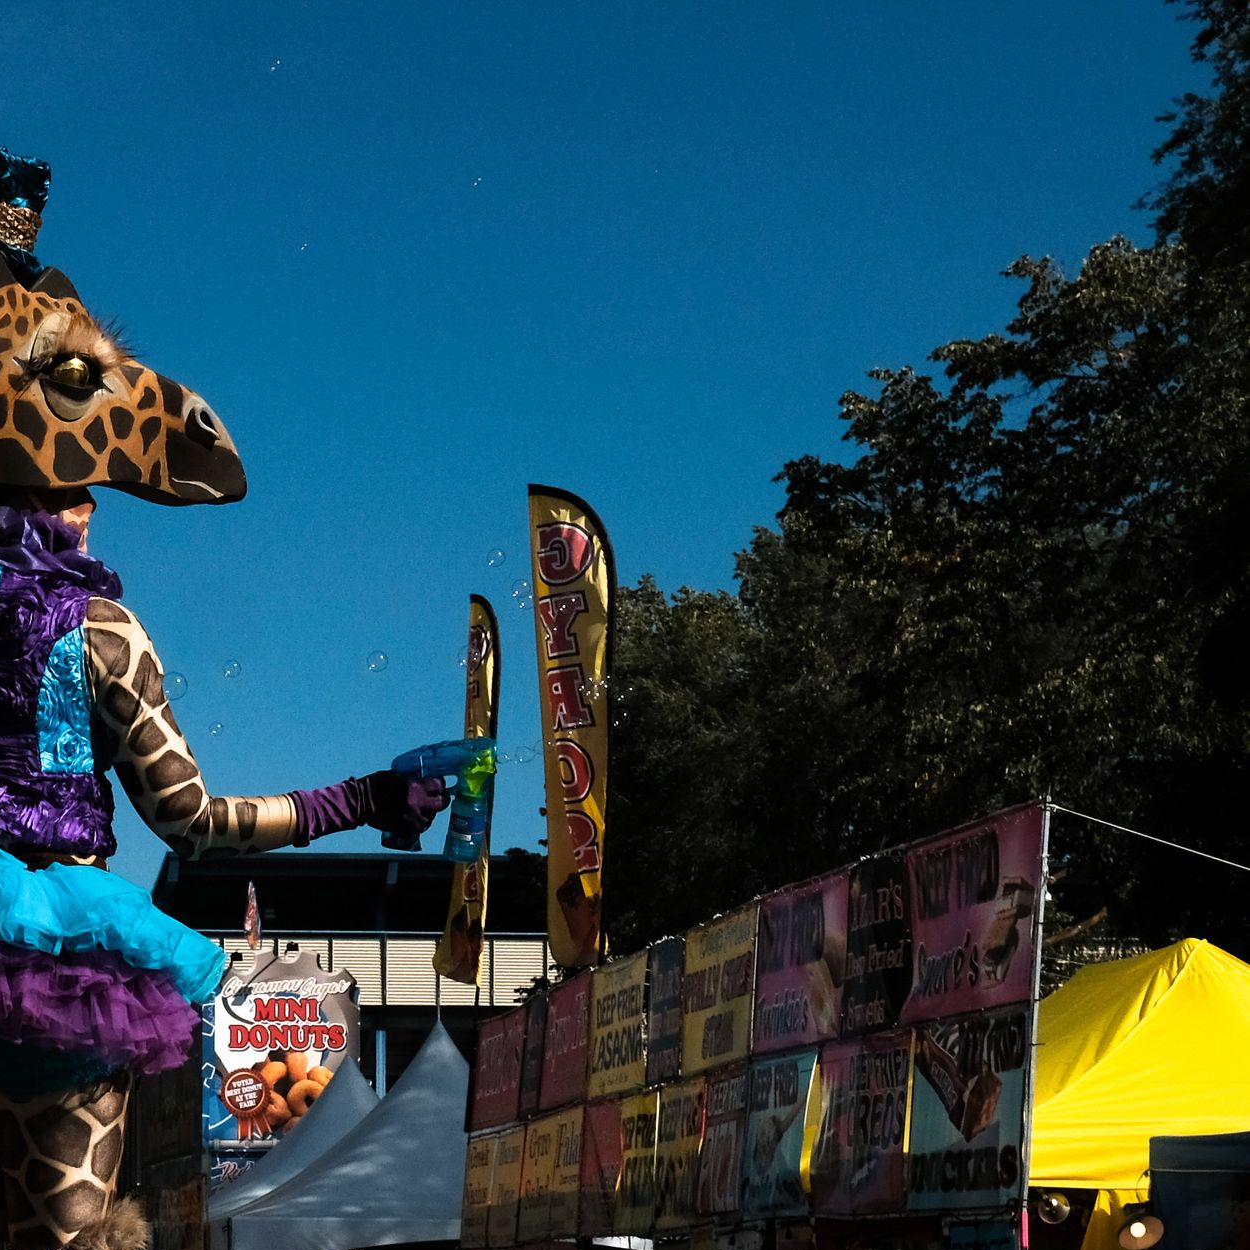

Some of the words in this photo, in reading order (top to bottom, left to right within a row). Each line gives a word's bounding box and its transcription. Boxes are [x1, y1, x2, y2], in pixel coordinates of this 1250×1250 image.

[301, 977, 351, 999] Sugar
[253, 997, 320, 1023] MINI
[596, 992, 616, 1029] DEEP
[616, 983, 642, 1021] FRIED
[227, 1024, 347, 1051] DONUTS
[231, 1078, 254, 1089] VOTED
[241, 1083, 263, 1095] DONUT
